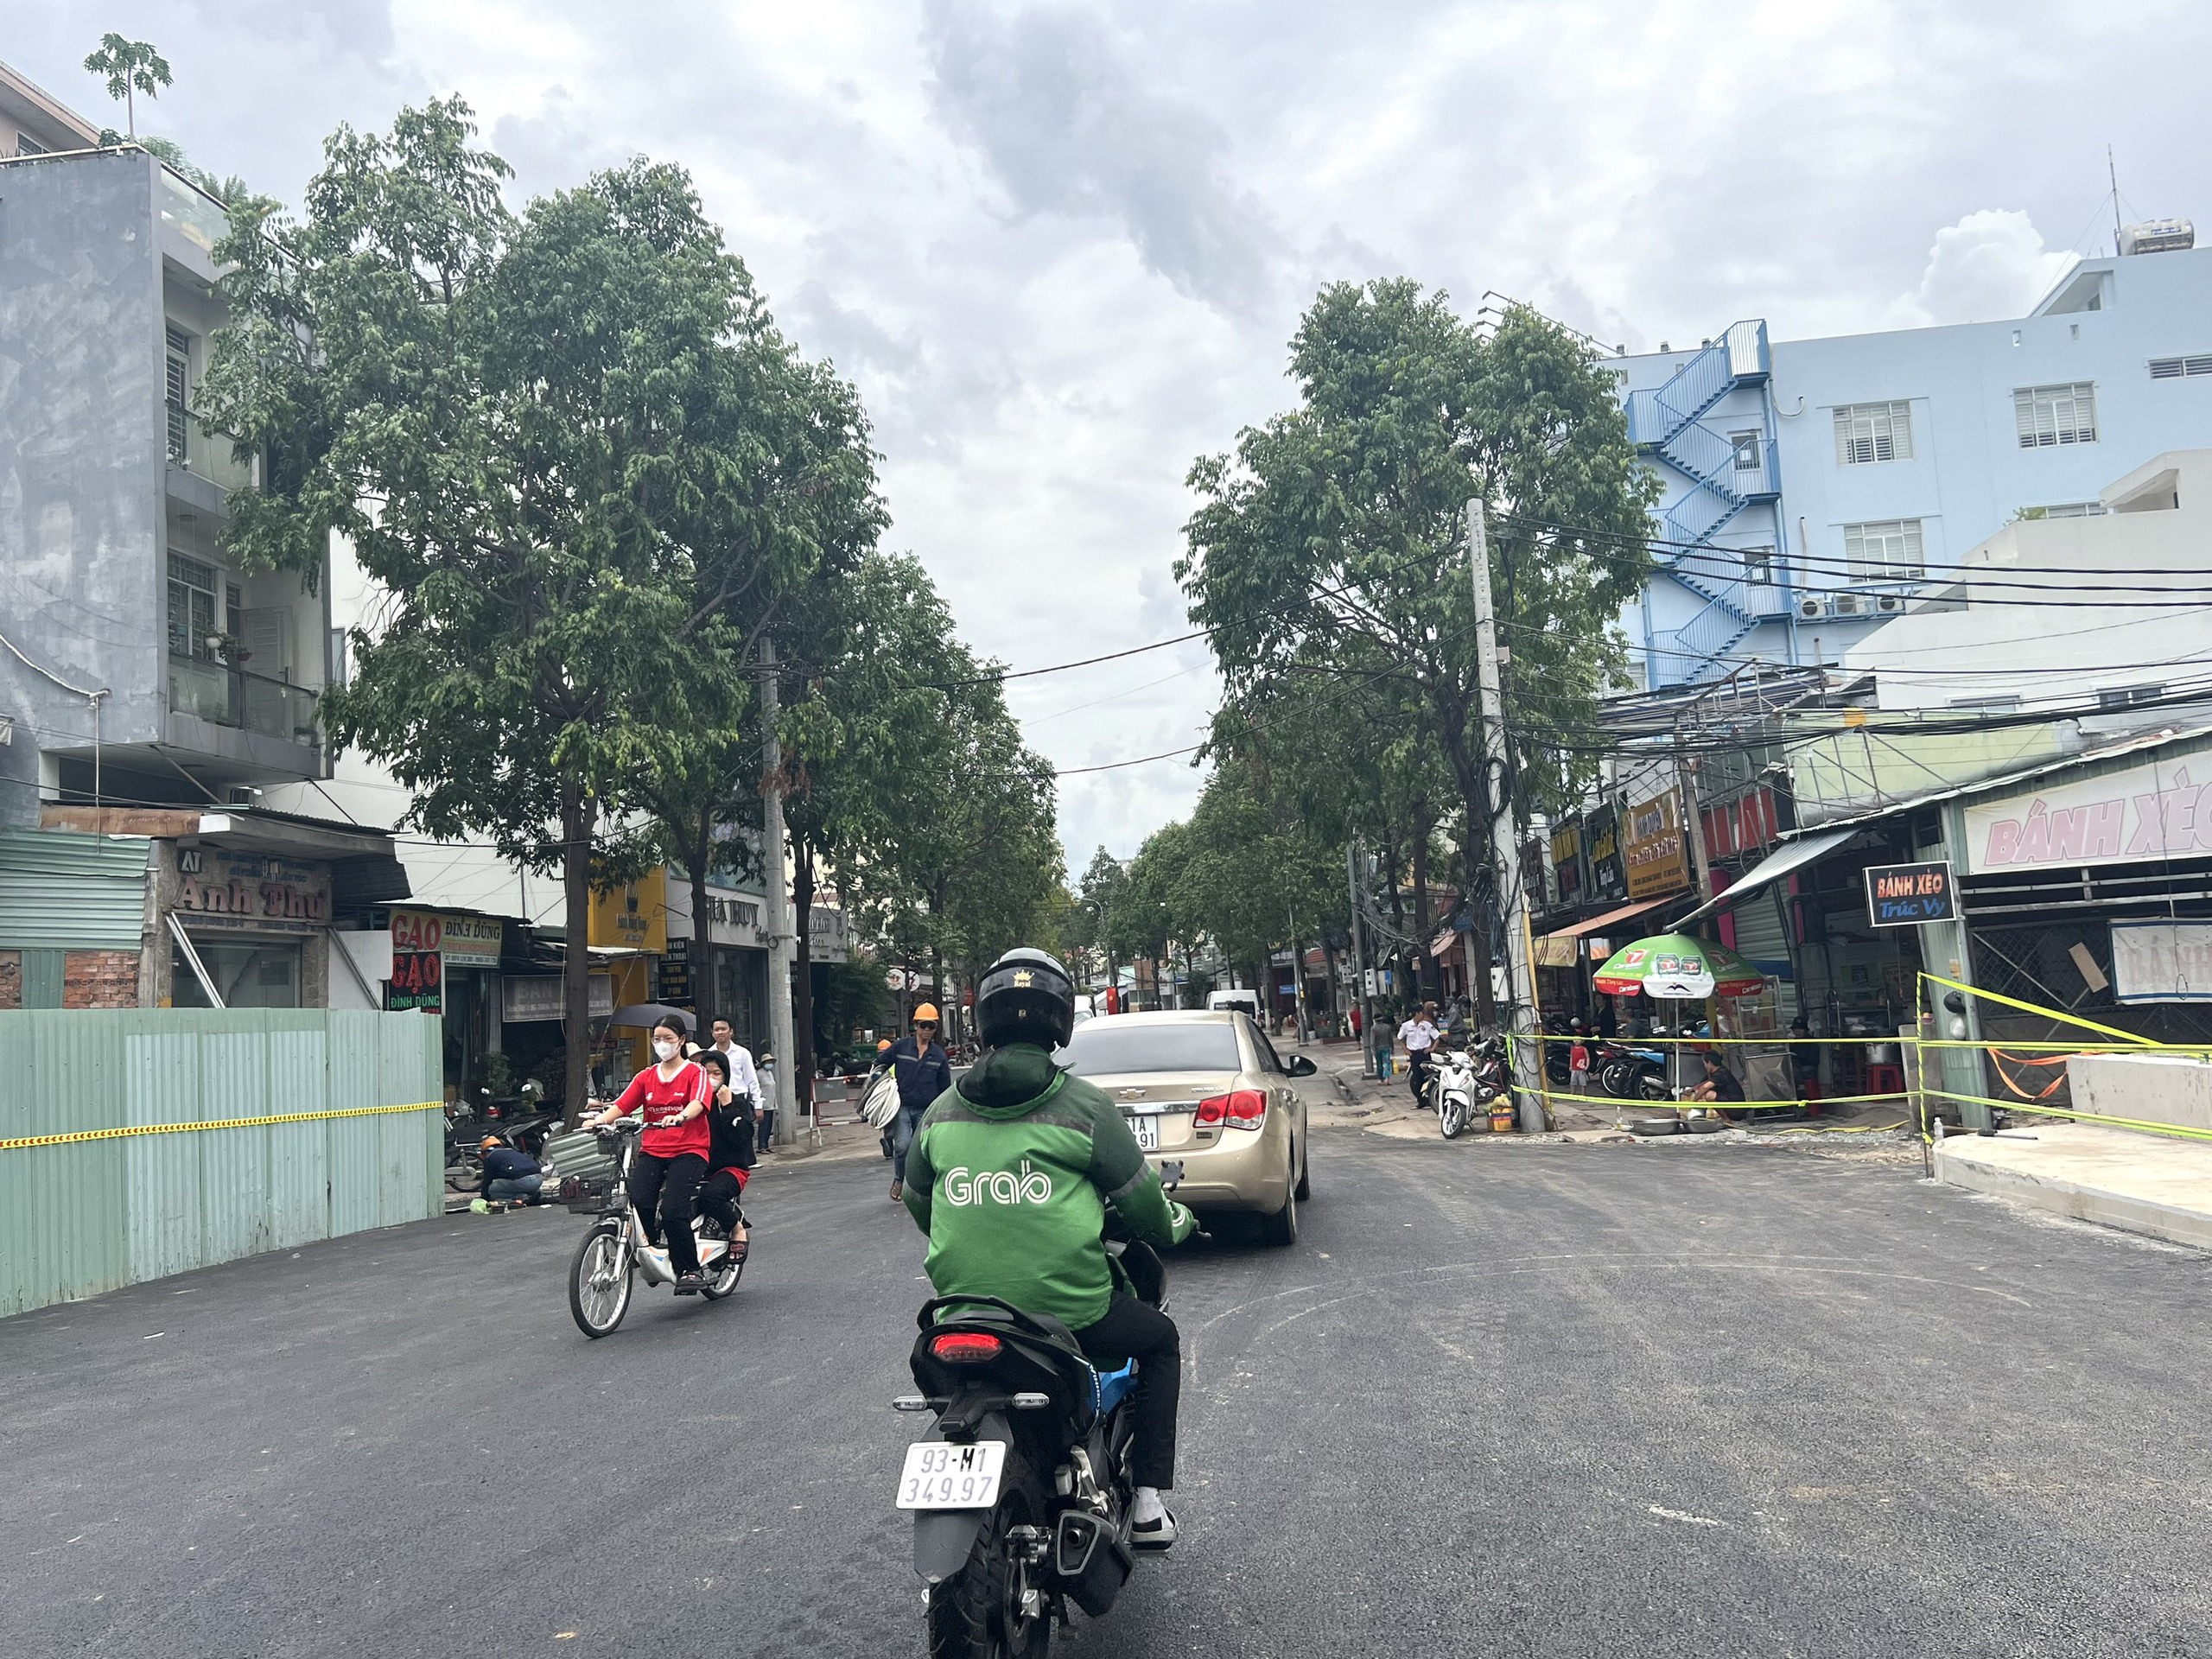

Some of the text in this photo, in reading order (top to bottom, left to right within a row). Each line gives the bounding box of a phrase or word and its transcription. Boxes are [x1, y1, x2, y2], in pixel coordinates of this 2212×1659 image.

[1985, 798, 2126, 867] BÁNH
[173, 874, 252, 913] Anh
[1877, 868, 1943, 898] BÁNH XÈO
[1879, 899, 1945, 918] Trúc Vy
[391, 954, 440, 994] GẠO
[1014, 980, 1031, 988] Royal
[391, 993, 440, 1008] ĐÌNH DŨNG
[944, 1160, 1052, 1207] Grab
[921, 1447, 986, 1473] 93-M1
[905, 1476, 993, 1503] 349.97
